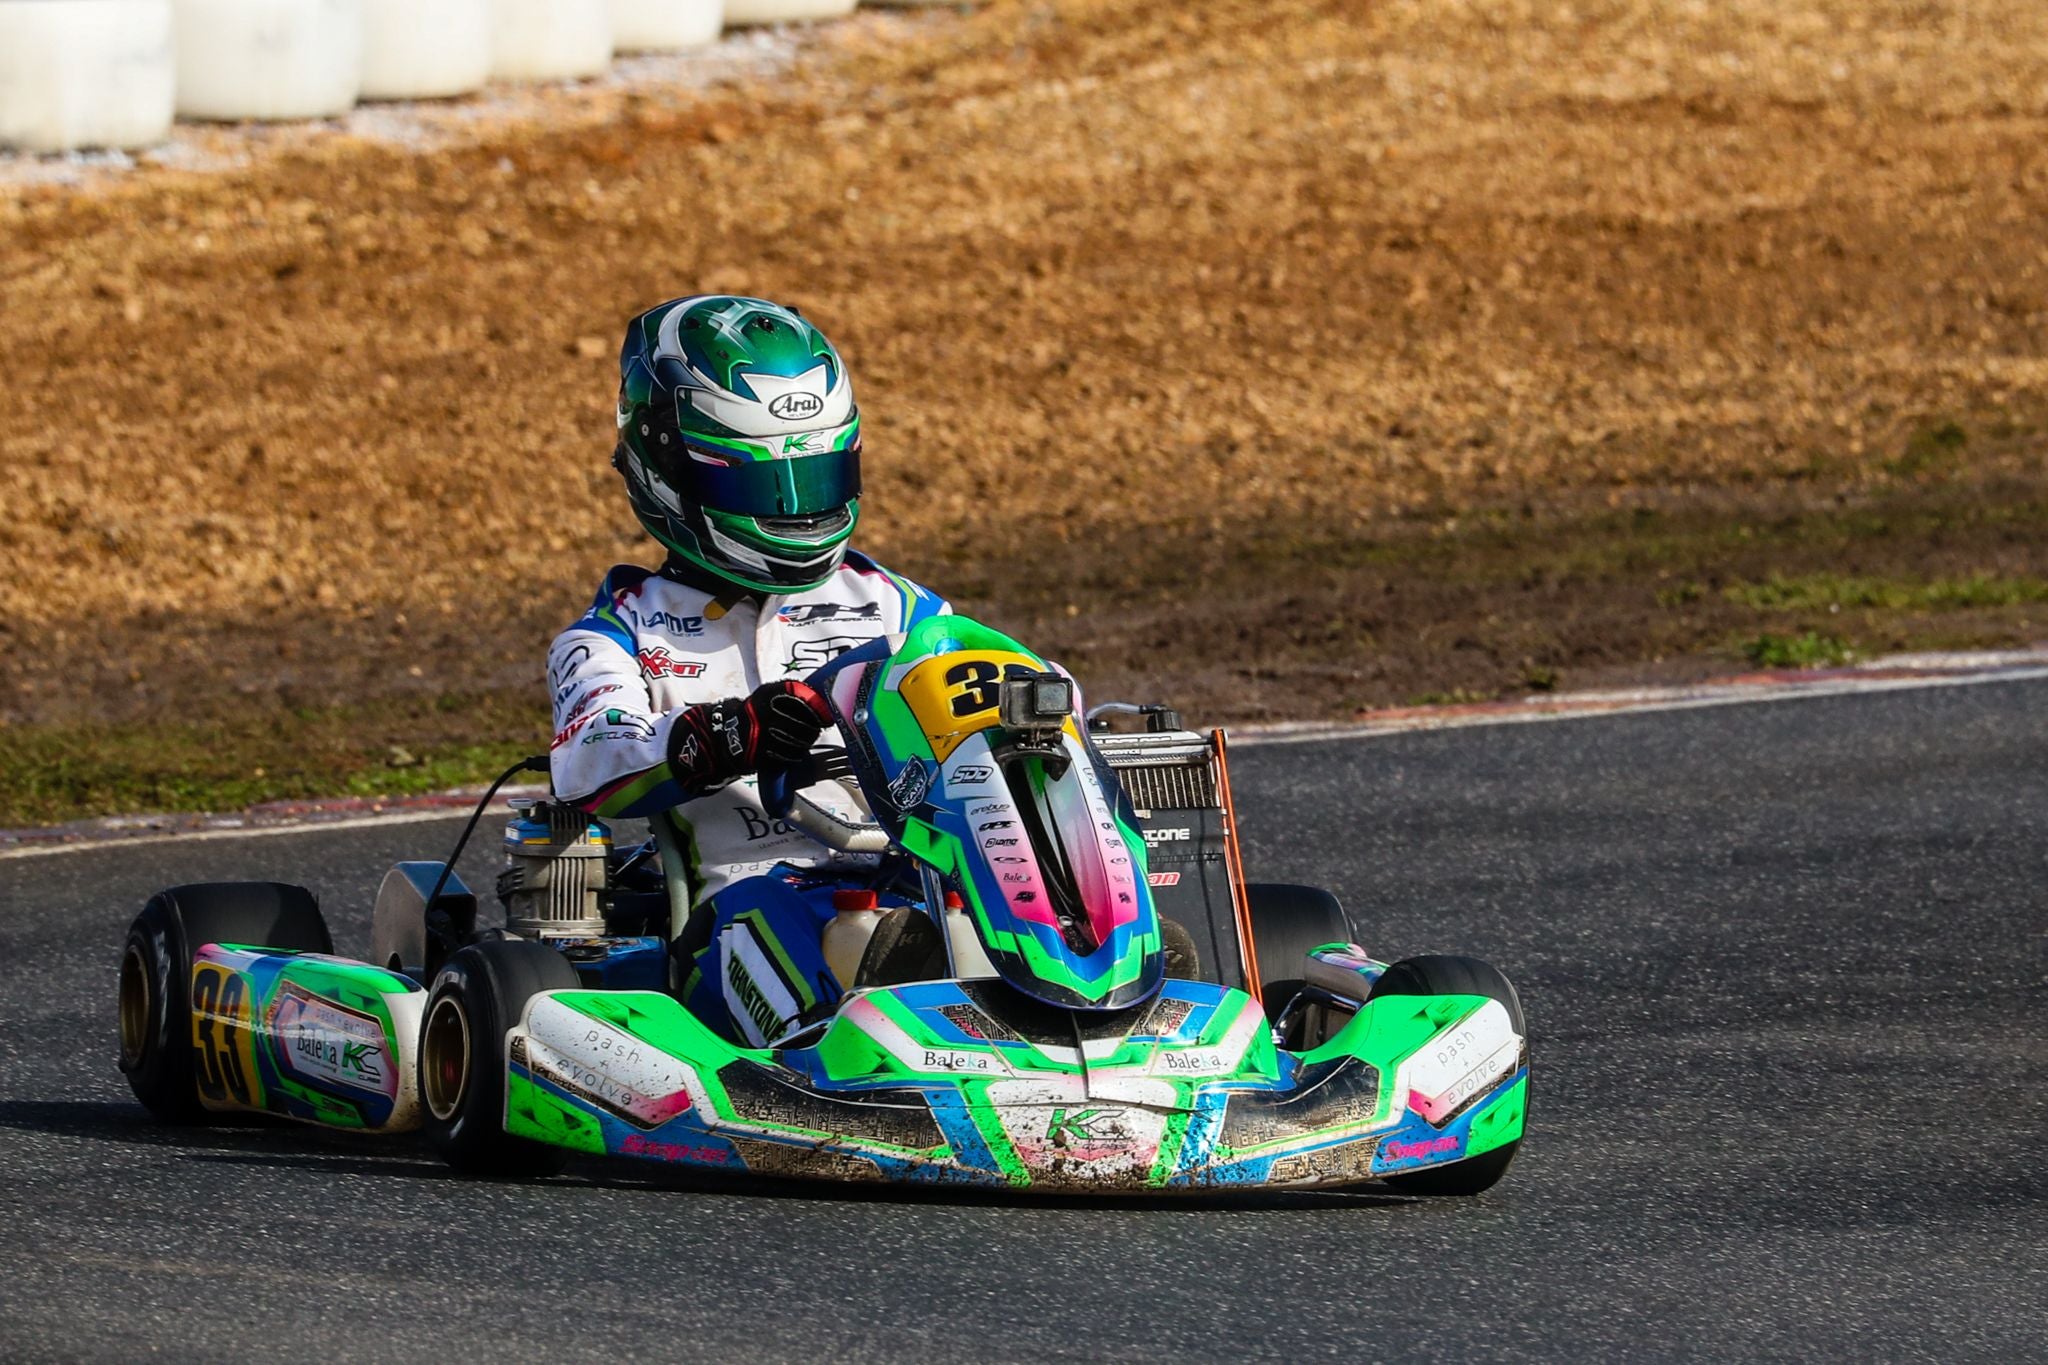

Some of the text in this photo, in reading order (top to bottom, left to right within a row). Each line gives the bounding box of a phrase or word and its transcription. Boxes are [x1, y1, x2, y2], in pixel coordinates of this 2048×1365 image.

[772, 395, 818, 412] Arai
[192, 968, 252, 1105] 33
[297, 1024, 338, 1066] Baleka
[584, 1030, 641, 1064] pash
[1437, 1031, 1476, 1067] pash
[924, 1051, 988, 1069] Baleka
[1164, 1052, 1221, 1069] Baleka
[556, 1059, 633, 1106] evolve
[1448, 1060, 1498, 1105] evolve
